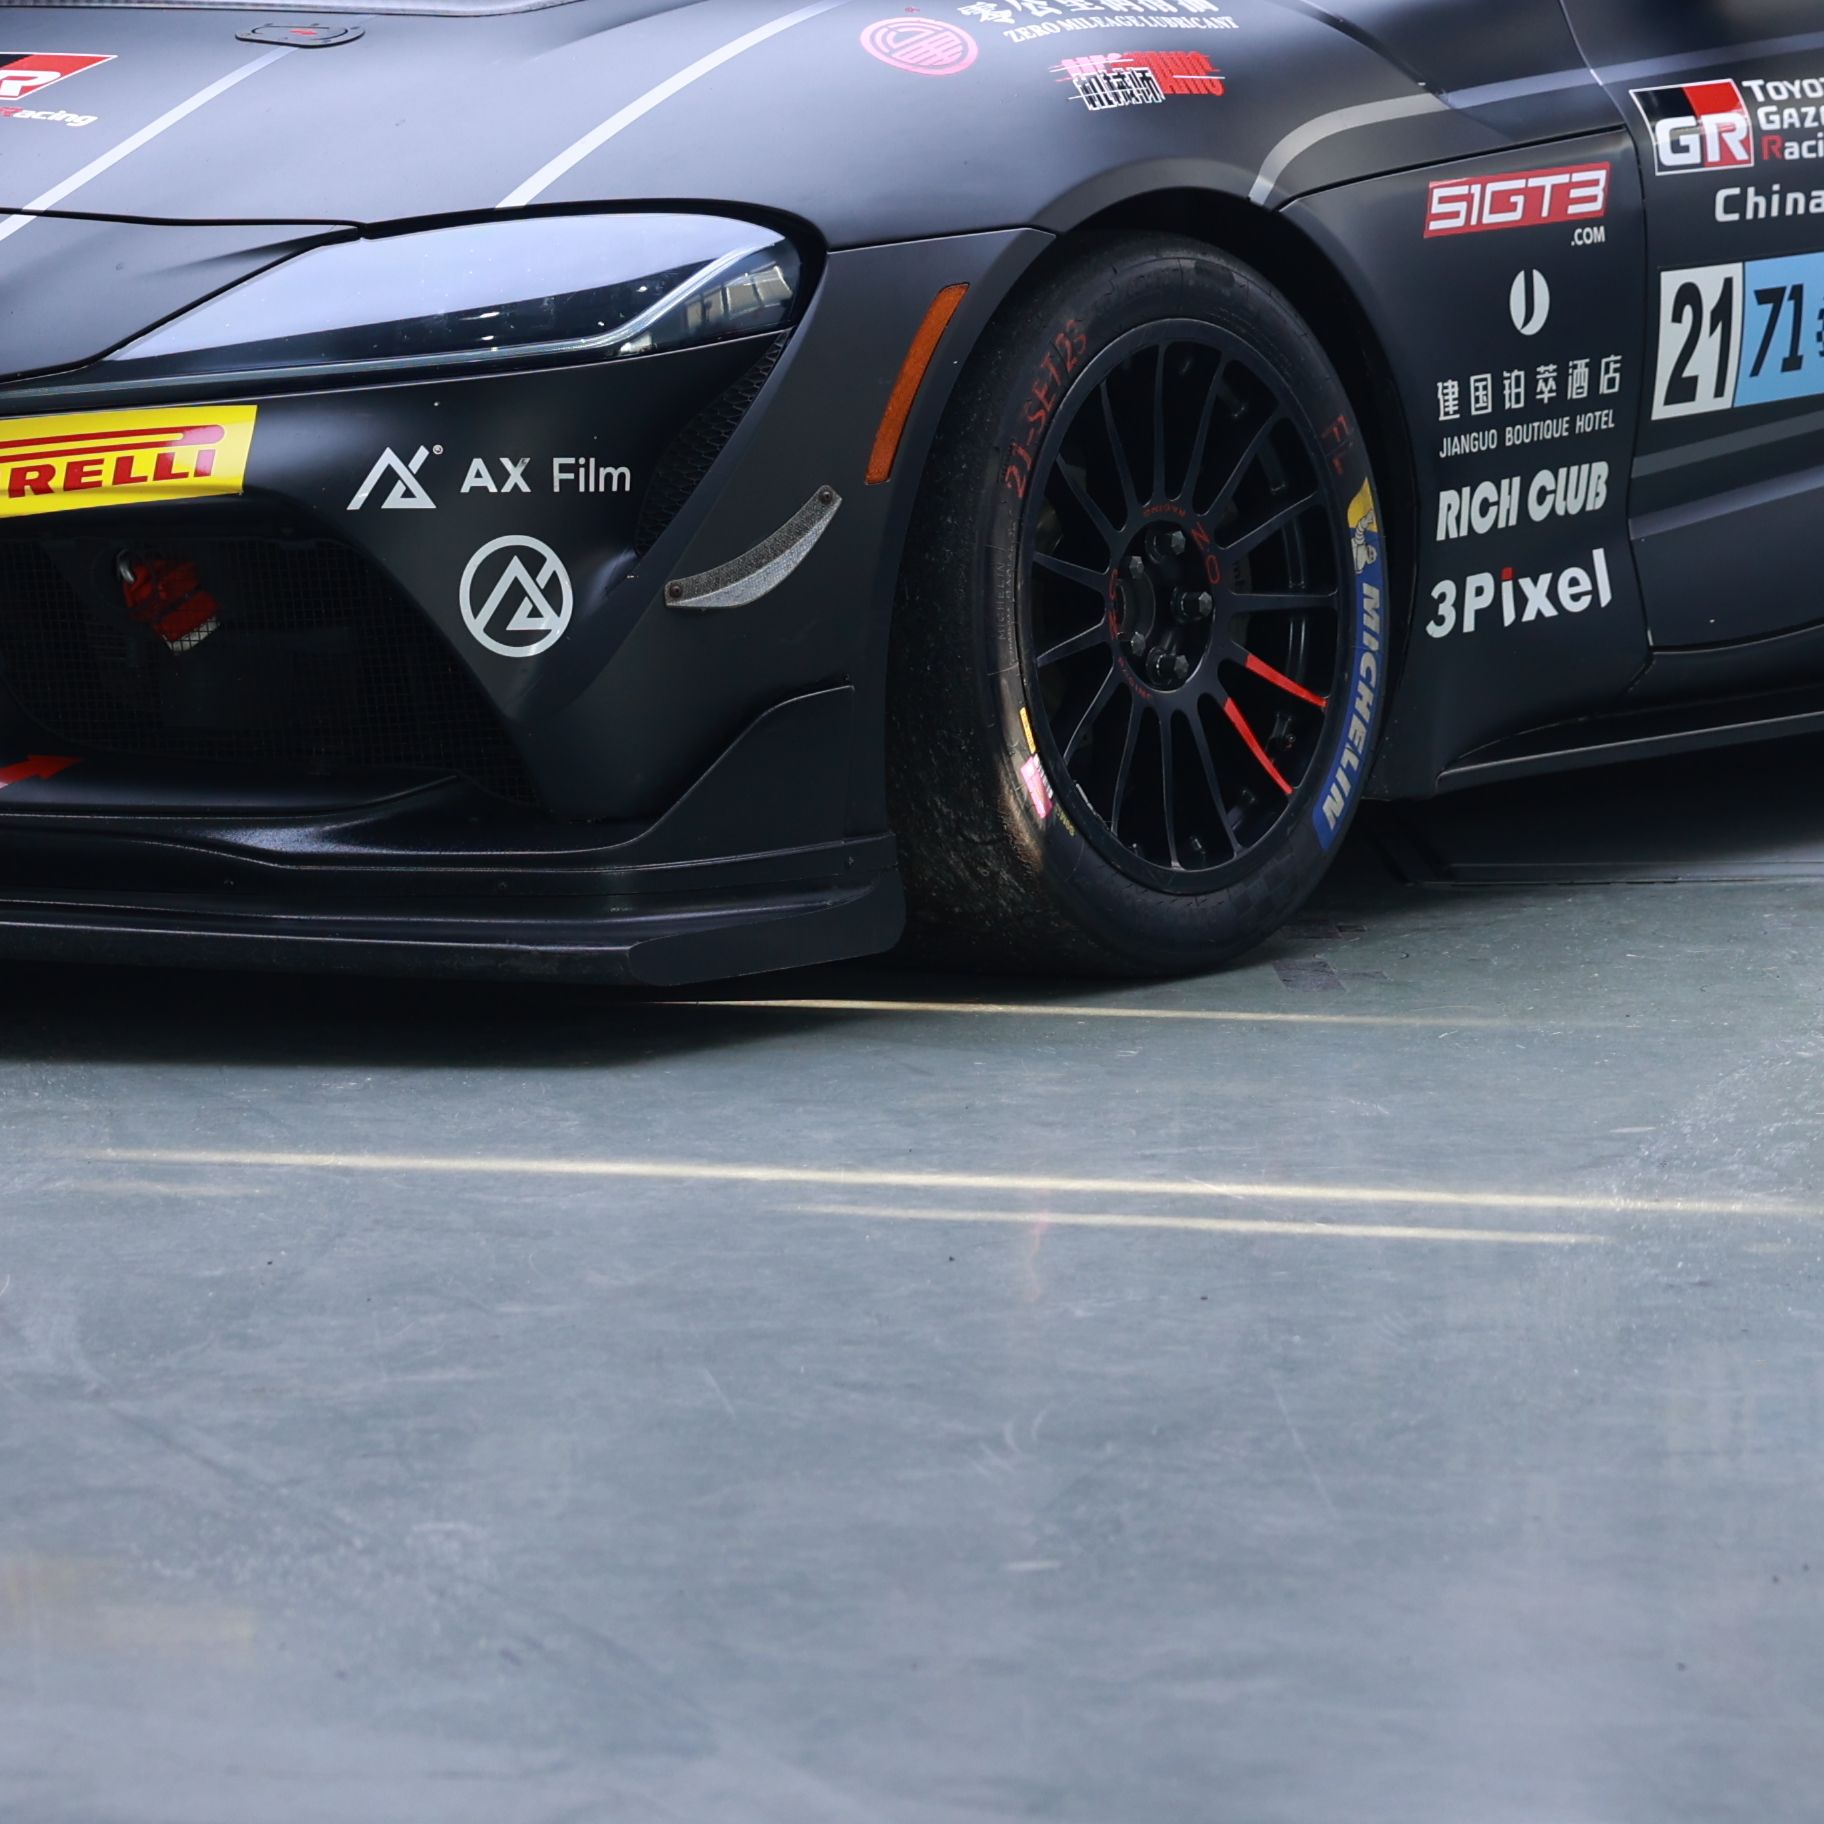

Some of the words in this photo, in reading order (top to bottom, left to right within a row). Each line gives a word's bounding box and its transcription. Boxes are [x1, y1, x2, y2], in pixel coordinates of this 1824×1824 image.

[1002, 22, 1061, 43] ZERO
[1060, 15, 1144, 33] MILEAGE
[1140, 14, 1240, 30] LUBRICANT
[1655, 112, 1750, 166] GR
[1571, 226, 1606, 247] .COM
[1663, 276, 1734, 407] 21
[1749, 283, 1804, 378] 71
[1436, 354, 1623, 421] 建国铂萃酒店
[1439, 429, 1498, 458] JIANGUO
[1505, 416, 1570, 447] BOUTIQUE
[1576, 409, 1615, 434] HOTEL
[460, 457, 532, 493] AX
[552, 457, 632, 493] Film
[1436, 476, 1521, 541] RICH
[1528, 461, 1609, 522] CLUB
[1426, 548, 1612, 639] 3Pixel
[1321, 581, 1381, 831] MICHELIN
